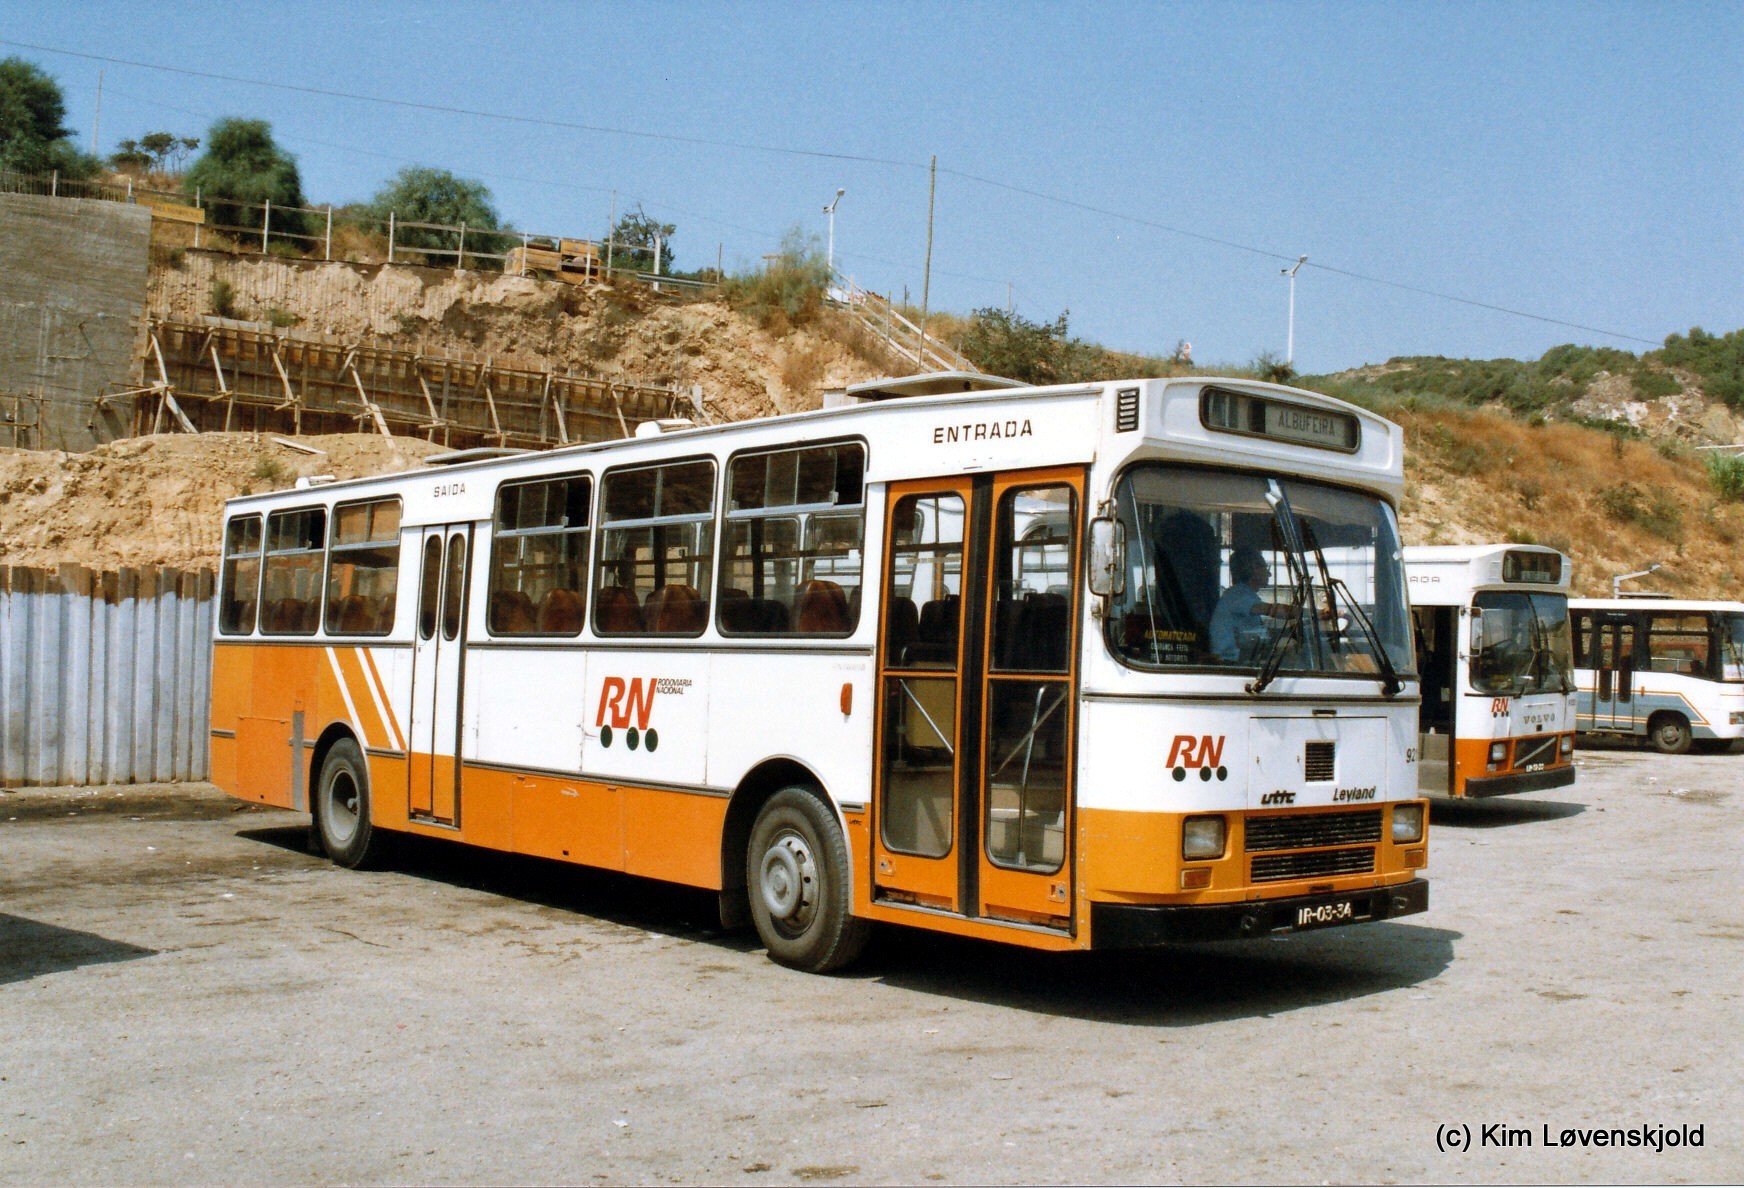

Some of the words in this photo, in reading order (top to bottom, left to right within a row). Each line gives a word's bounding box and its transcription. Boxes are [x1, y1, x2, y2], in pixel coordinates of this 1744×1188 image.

[933, 419, 1033, 444] ENTRADA
[1278, 410, 1336, 437] ALBUFEIRA
[434, 483, 466, 498] SAIDA
[656, 686, 685, 696] NACIONAL
[657, 678, 693, 688] RODOVIARIA
[596, 676, 658, 731] RN
[1491, 697, 1509, 713] RN
[1523, 712, 1556, 725] VOLVO
[1165, 735, 1226, 769] RN
[1332, 785, 1377, 803] Leyland
[1298, 901, 1352, 926] IR-03-34
